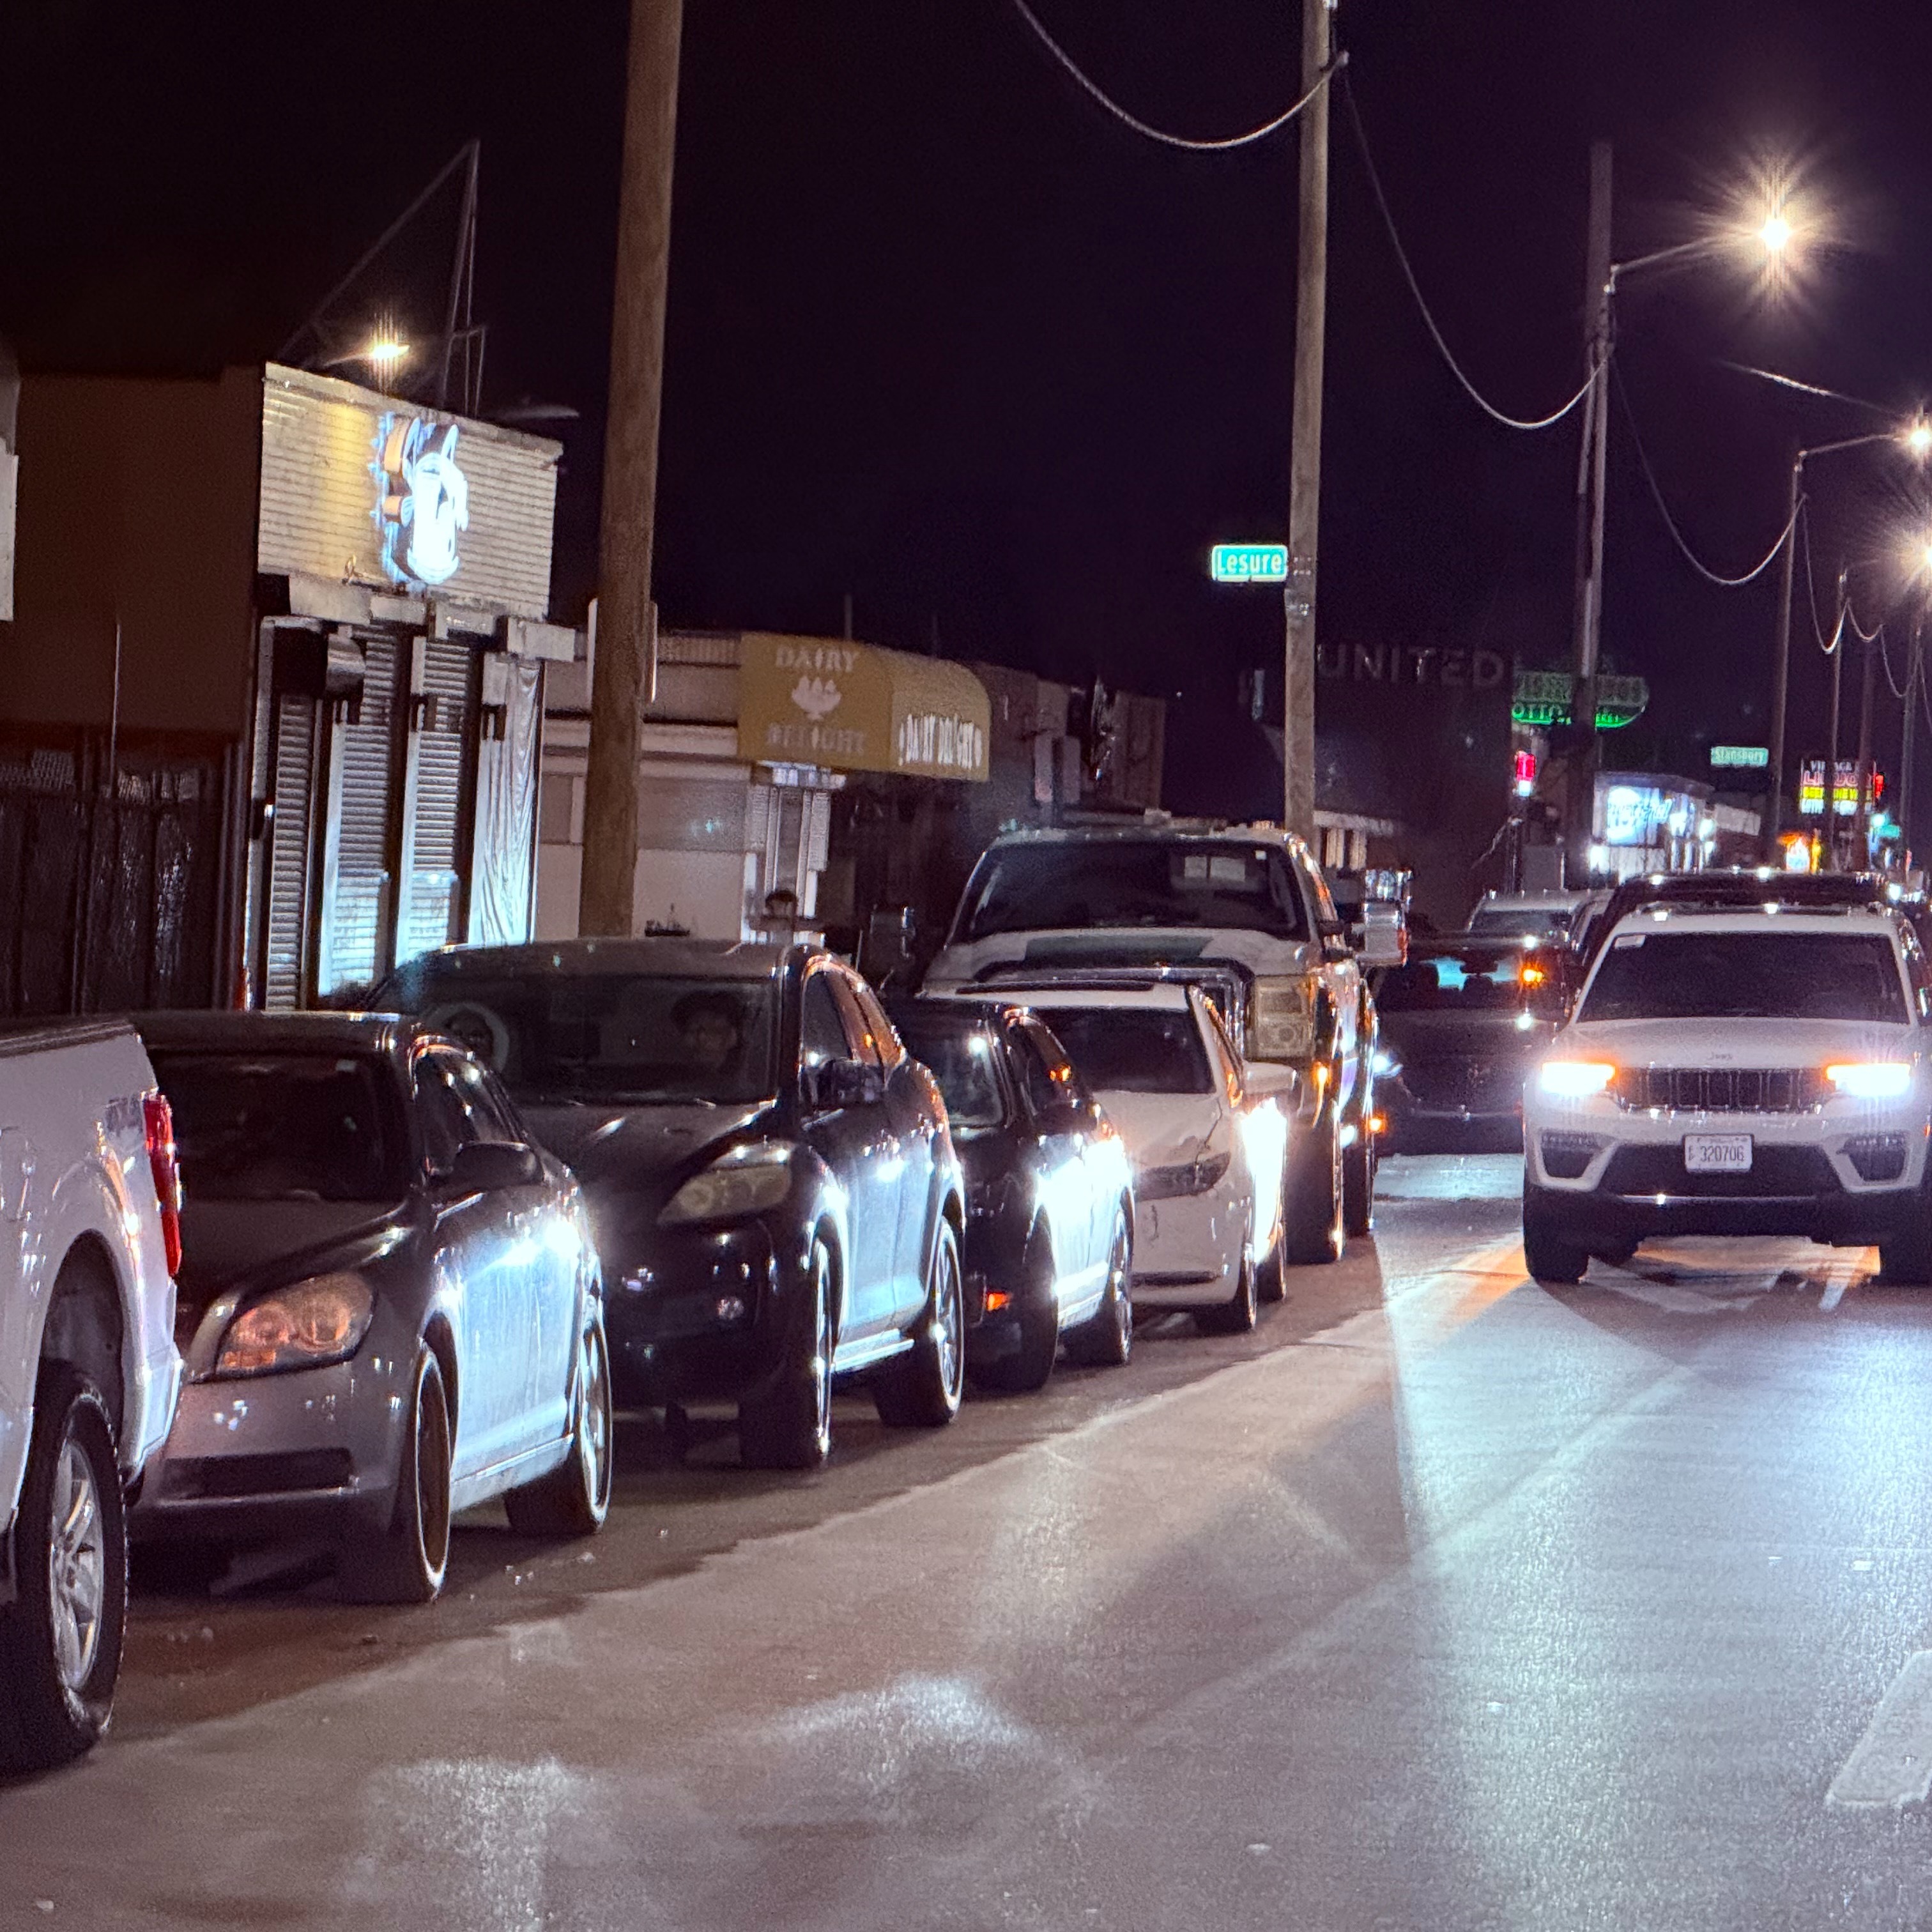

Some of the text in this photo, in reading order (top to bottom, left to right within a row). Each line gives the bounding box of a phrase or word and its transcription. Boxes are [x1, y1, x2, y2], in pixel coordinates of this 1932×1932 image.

[1217, 551, 1283, 574] Lesure
[775, 645, 859, 673] DAIRY
[1317, 643, 1505, 687] UNITED
